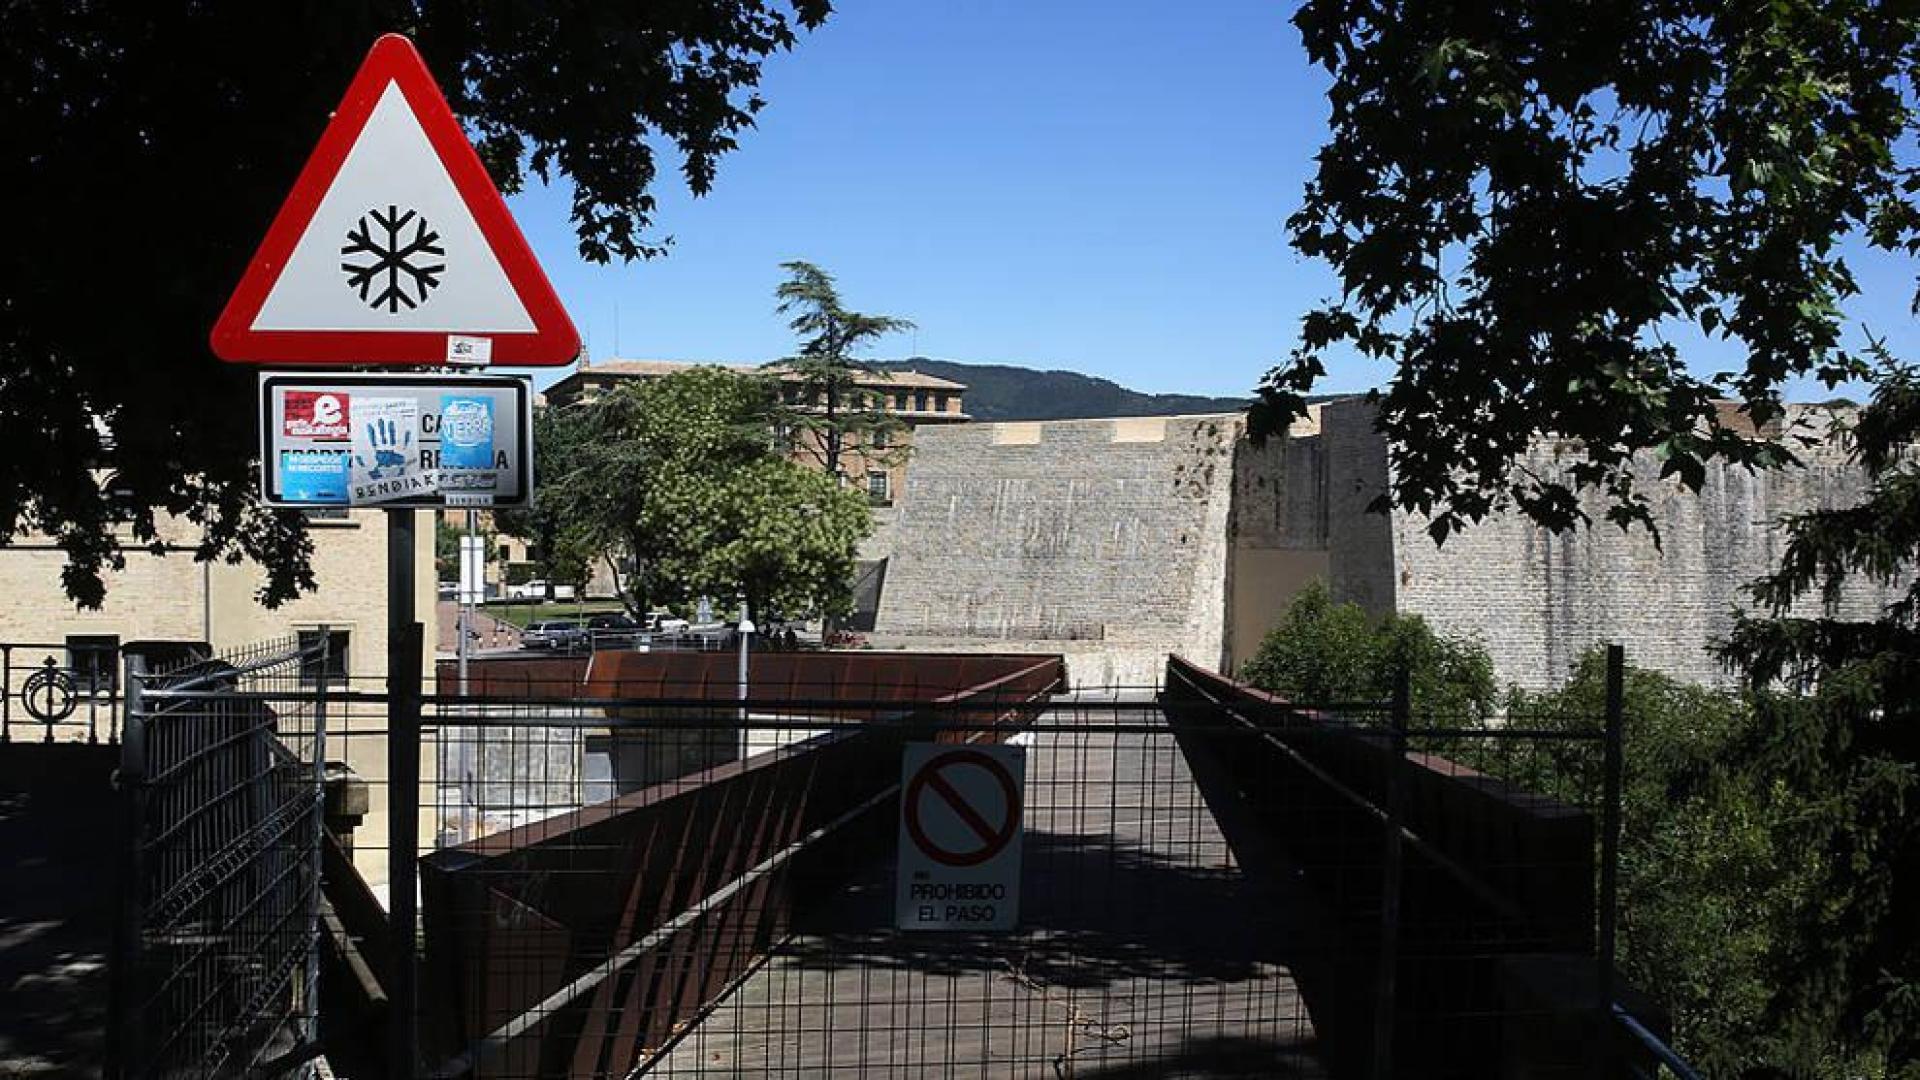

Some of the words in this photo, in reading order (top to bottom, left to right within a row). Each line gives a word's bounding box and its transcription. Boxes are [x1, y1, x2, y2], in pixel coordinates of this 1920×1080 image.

[911, 883, 1005, 900] PROHIBIDO
[919, 905, 938, 921] EL
[946, 904, 995, 921] PASO
